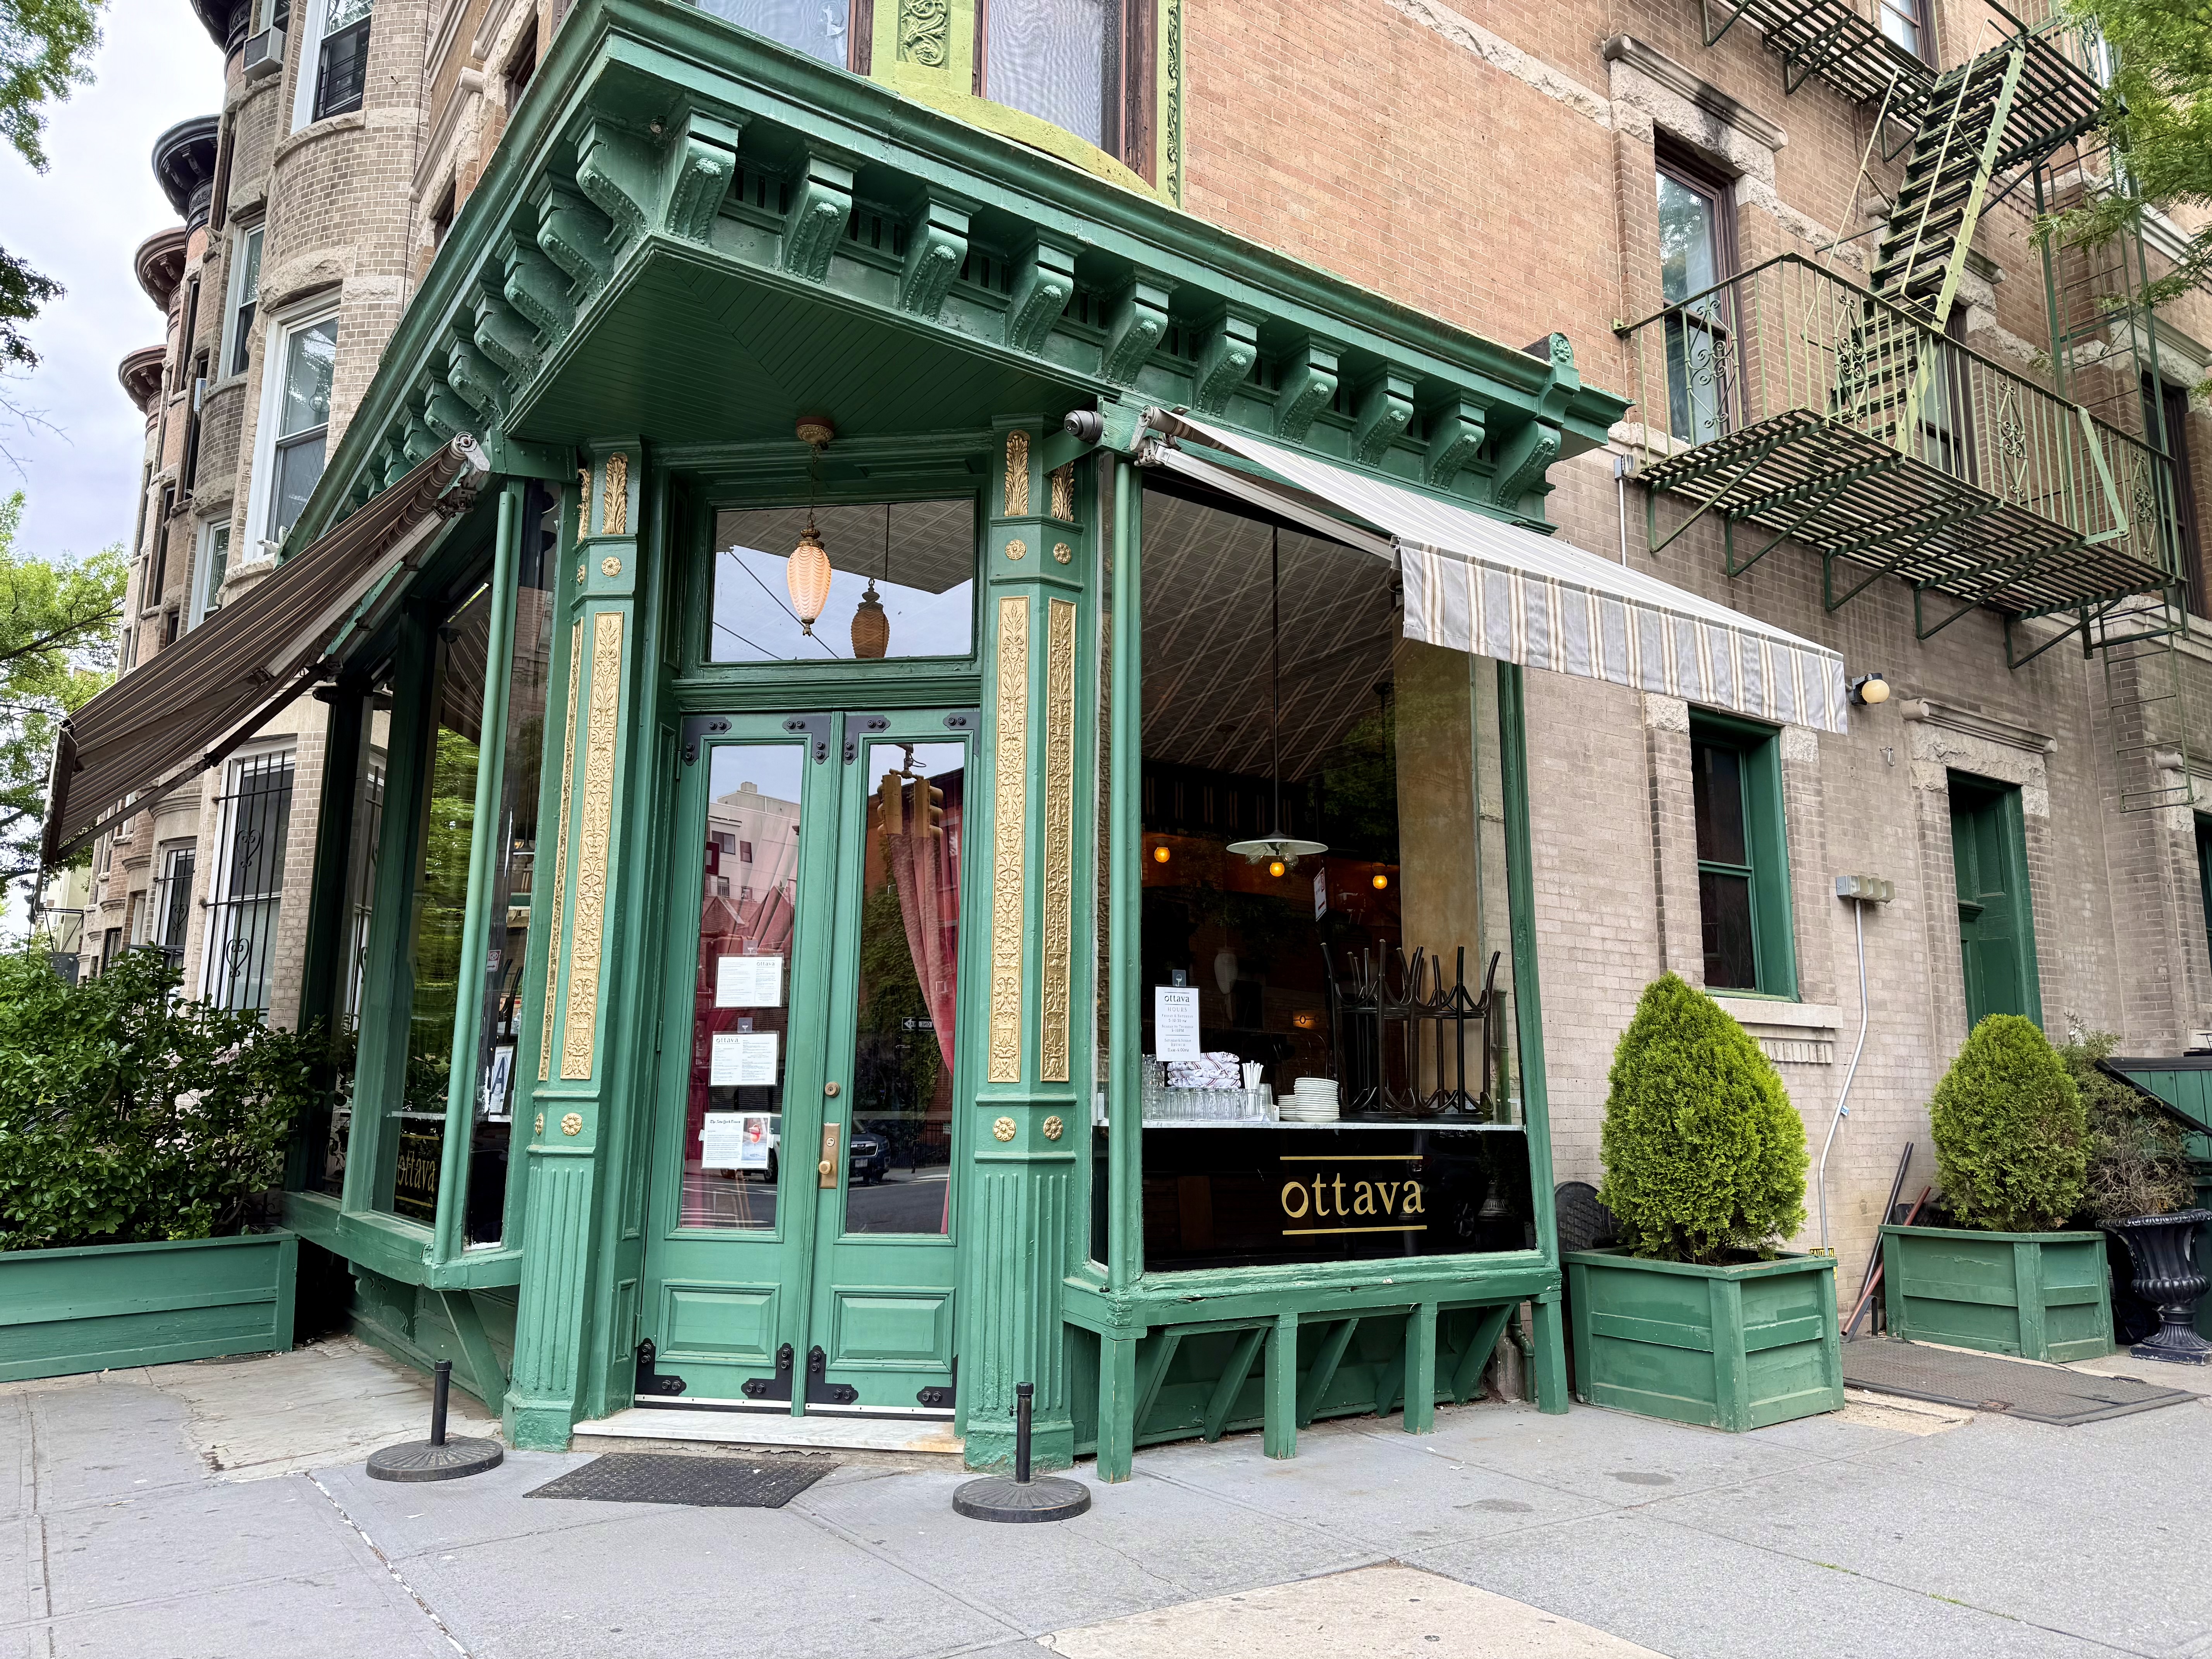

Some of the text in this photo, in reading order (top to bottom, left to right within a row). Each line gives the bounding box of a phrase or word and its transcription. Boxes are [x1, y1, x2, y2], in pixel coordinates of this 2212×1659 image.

[491, 1057, 505, 1094] A
[397, 1149, 436, 1192] ottava
[1281, 1173, 1425, 1218] ottava
